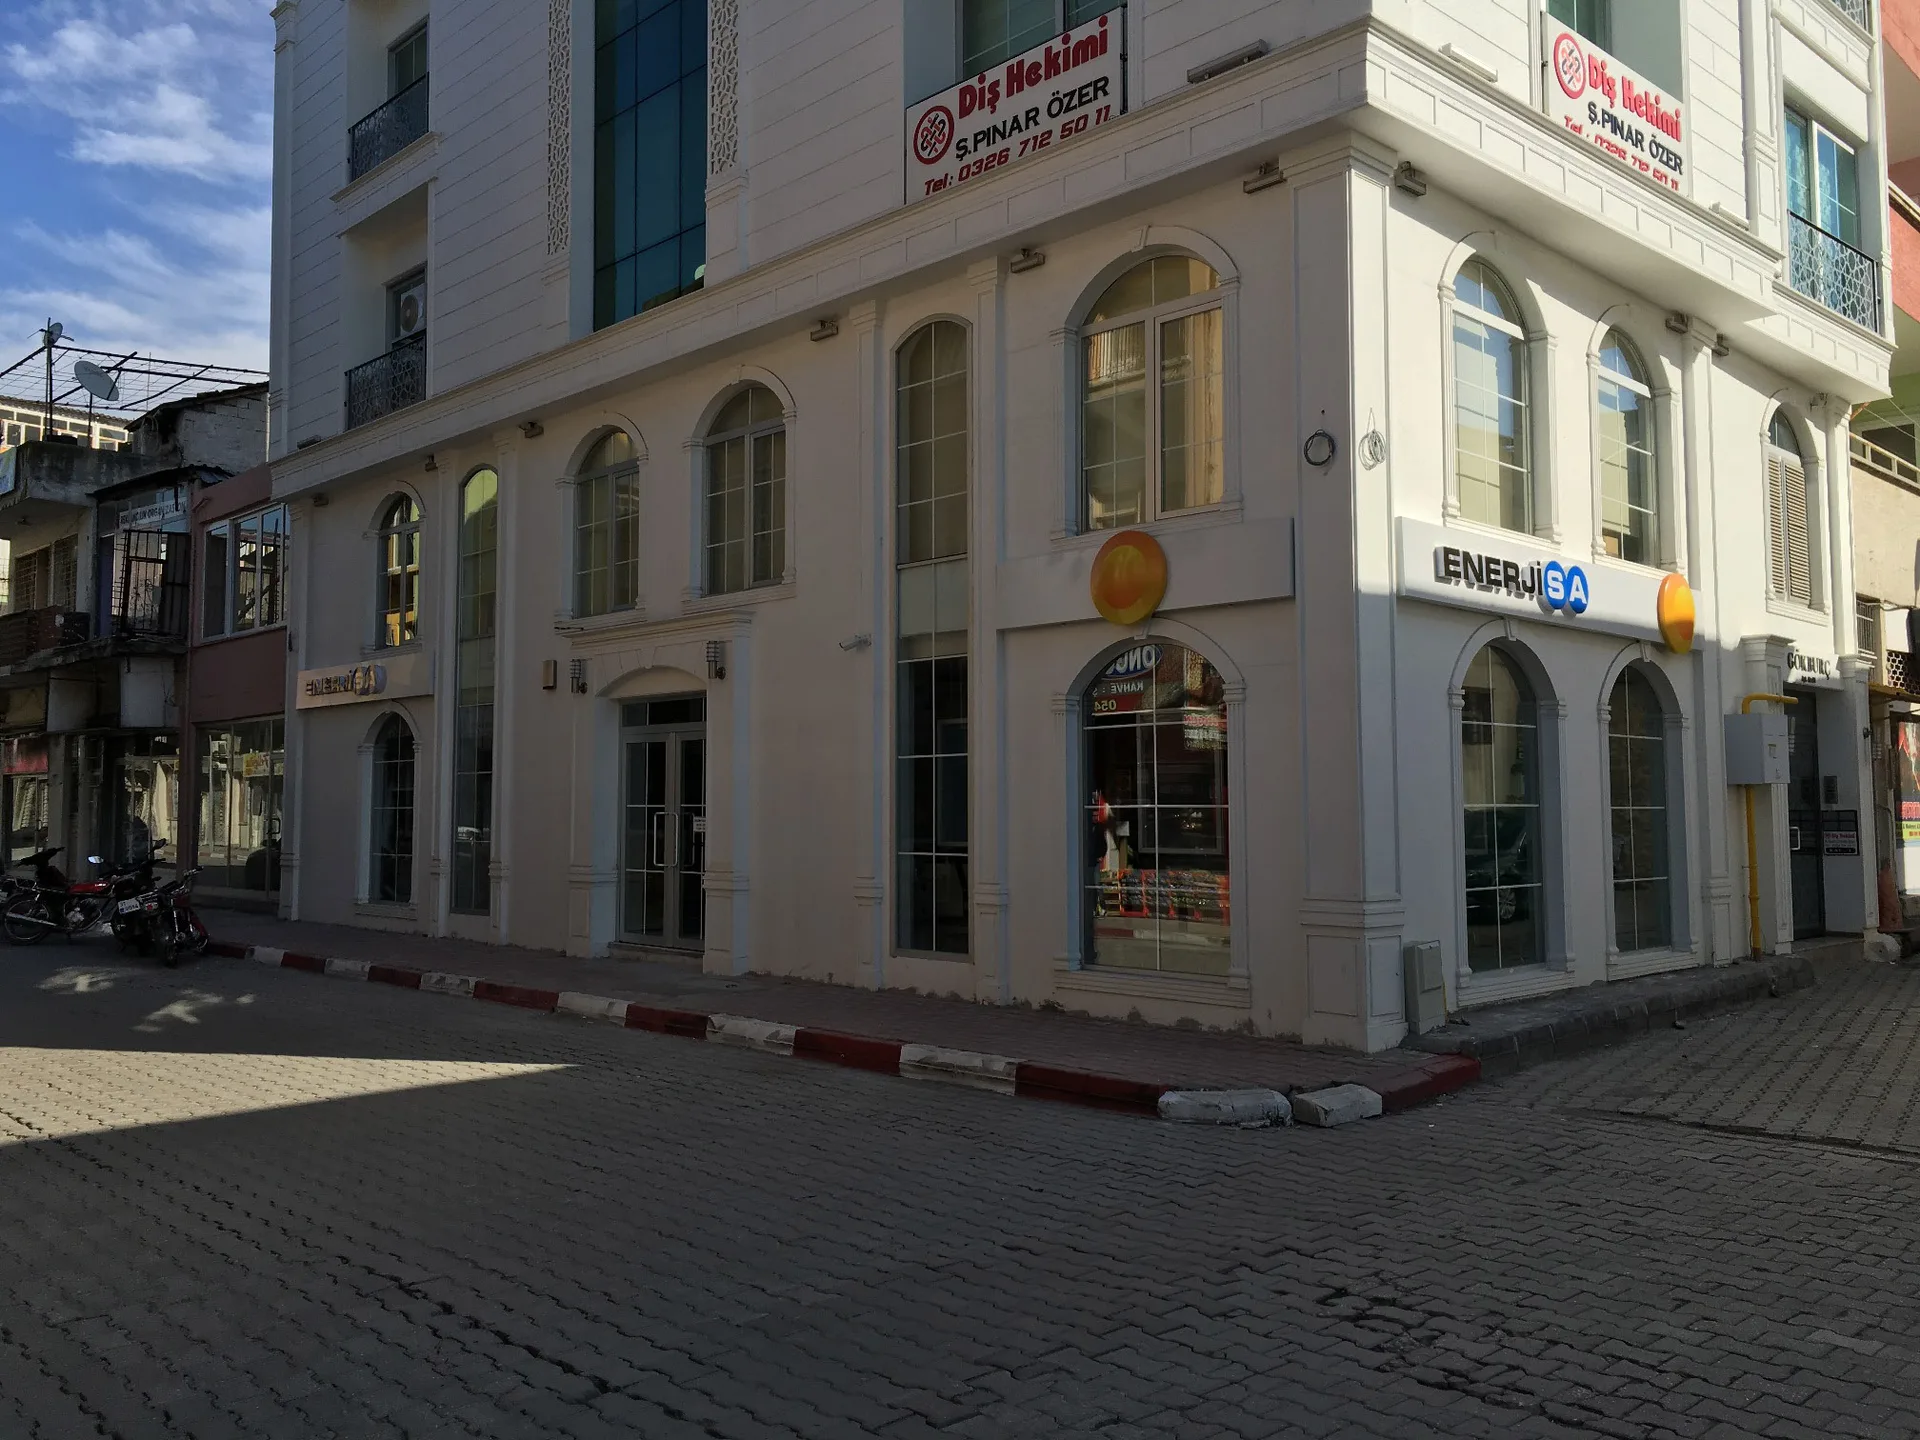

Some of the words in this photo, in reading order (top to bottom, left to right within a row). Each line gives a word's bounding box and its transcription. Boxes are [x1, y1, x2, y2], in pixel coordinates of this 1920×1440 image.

[958, 72, 1001, 120] Diş
[1006, 15, 1109, 99] Hekimi
[1587, 53, 1617, 109] Diş
[1621, 75, 1682, 143] Hekimi
[955, 107, 1040, 162] Ş.PINAR
[1046, 76, 1110, 119] ÖZER
[958, 147, 1011, 182] 0326
[1018, 129, 1053, 158] 712
[1059, 113, 1089, 140] 50
[1095, 104, 1112, 125] 11
[1587, 101, 1645, 152] Ş.PINAR
[1648, 135, 1684, 176] ÖZER
